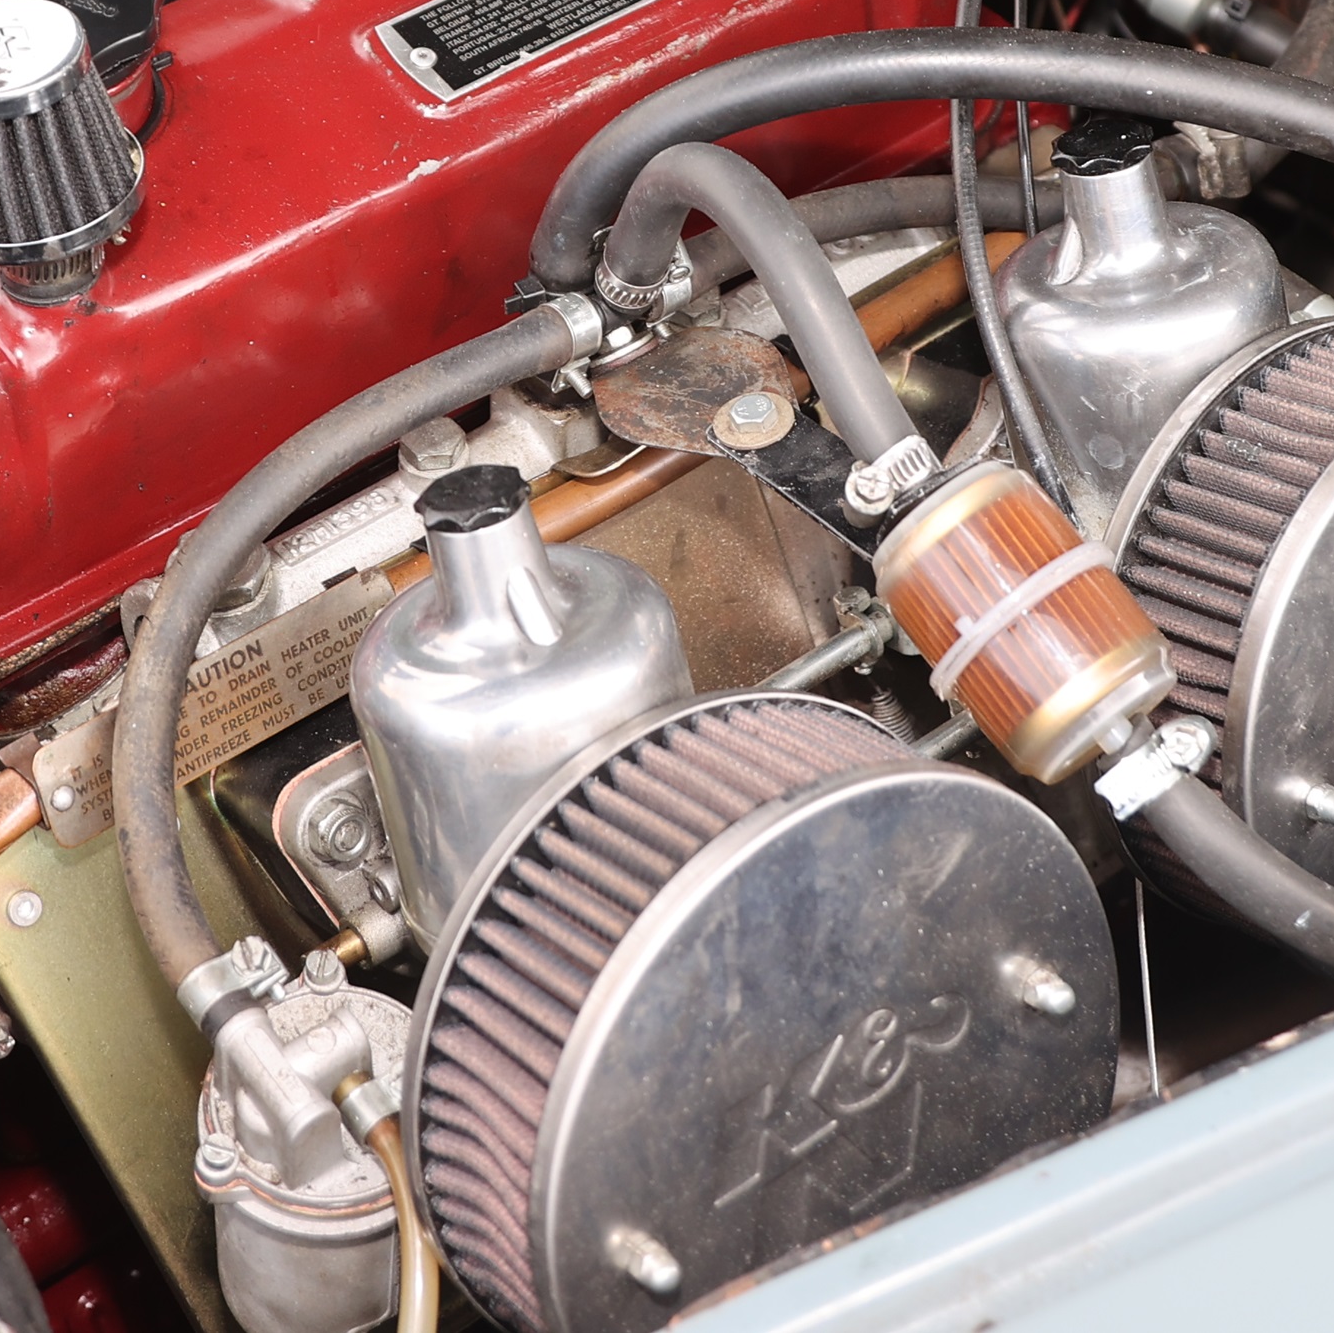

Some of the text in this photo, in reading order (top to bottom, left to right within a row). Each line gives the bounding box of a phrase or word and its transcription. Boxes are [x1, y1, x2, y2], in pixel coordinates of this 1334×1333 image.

[418, 9, 439, 22] THE
[430, 13, 472, 35] BELGIUM
[438, 2, 474, 22] BRITAIN
[544, 2, 597, 31] WESTLAKE
[457, 43, 490, 62] SOUTH
[91, 752, 104, 770] IS
[196, 687, 218, 711] TO
[227, 657, 272, 694] DRAIN
[280, 625, 331, 665] HEATER
[337, 605, 368, 634] UNIT
[180, 636, 264, 699] AUTION
[198, 674, 278, 729] REMAINDER
[284, 658, 304, 681] OF
[312, 622, 370, 666] COOLIN
[171, 731, 210, 763] NDER
[220, 689, 283, 737] FREEZING
[174, 726, 252, 781] ANTIFREEZE
[261, 701, 296, 733] MUST
[307, 685, 325, 707] BE
